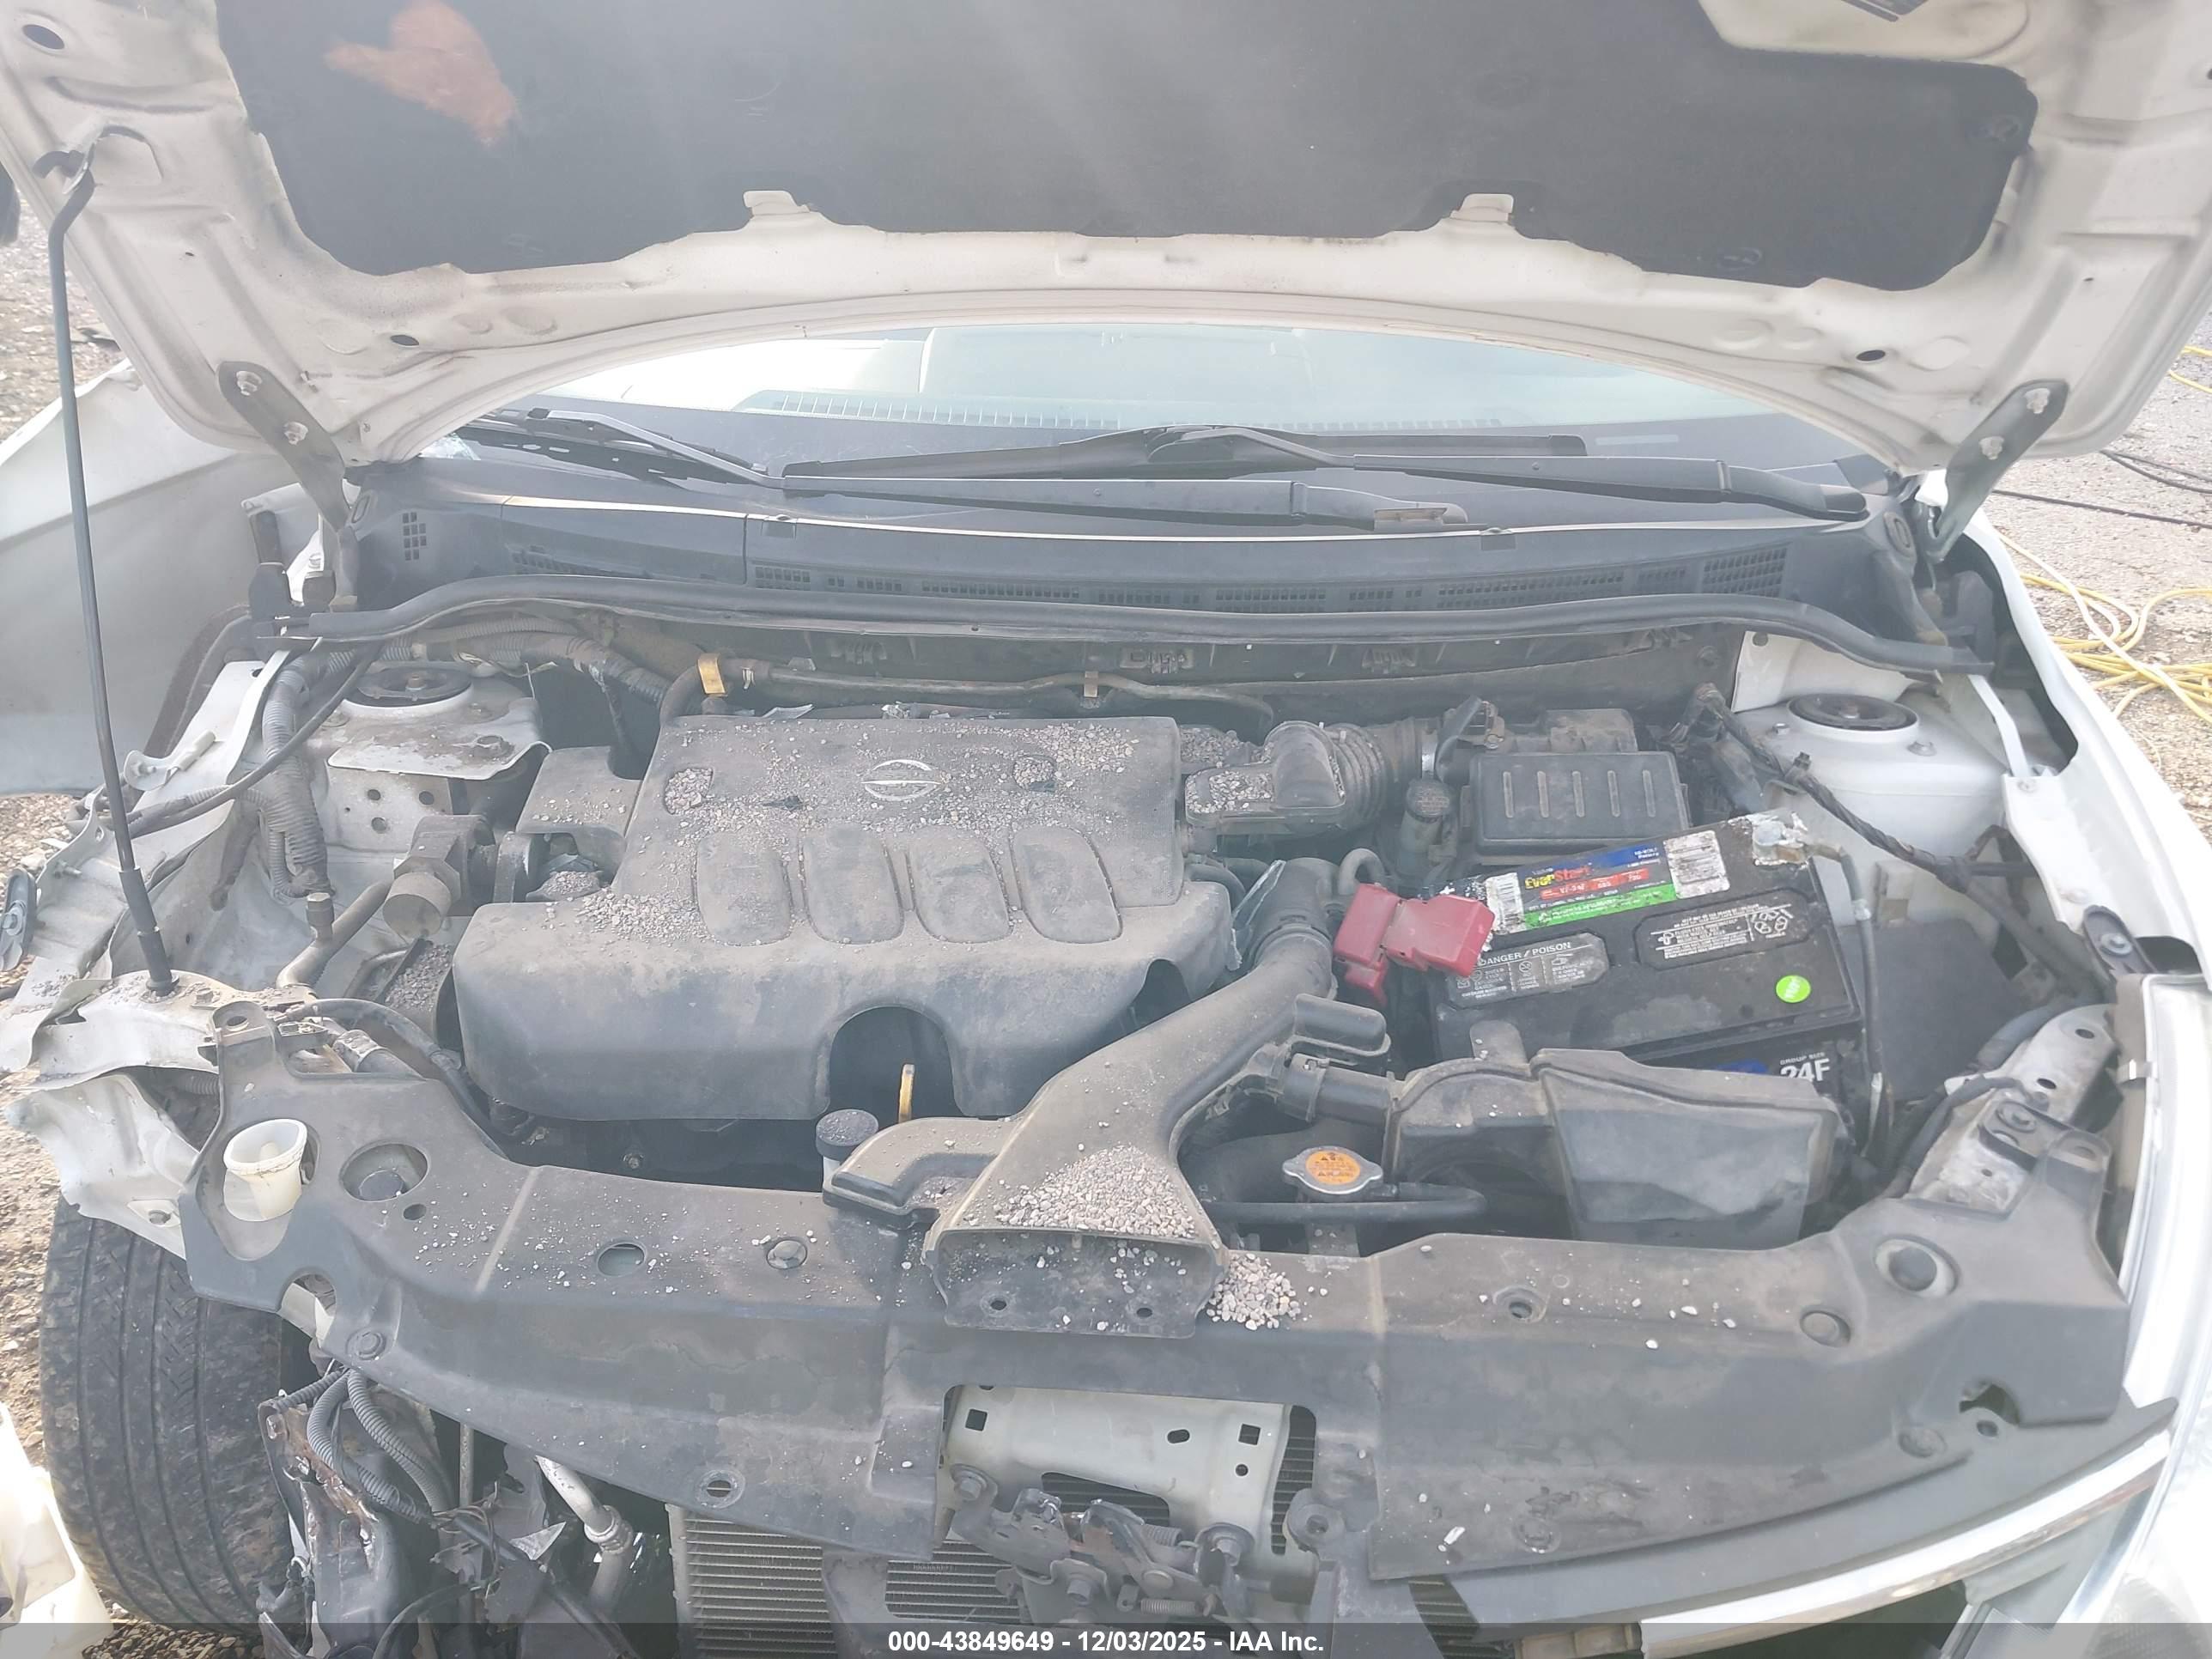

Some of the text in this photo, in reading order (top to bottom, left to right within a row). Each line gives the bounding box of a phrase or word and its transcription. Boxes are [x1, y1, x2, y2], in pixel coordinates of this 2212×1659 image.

[1479, 951, 1522, 966] DANGER
[1532, 942, 1571, 956] POISON
[1780, 1058, 1831, 1082] 24F
